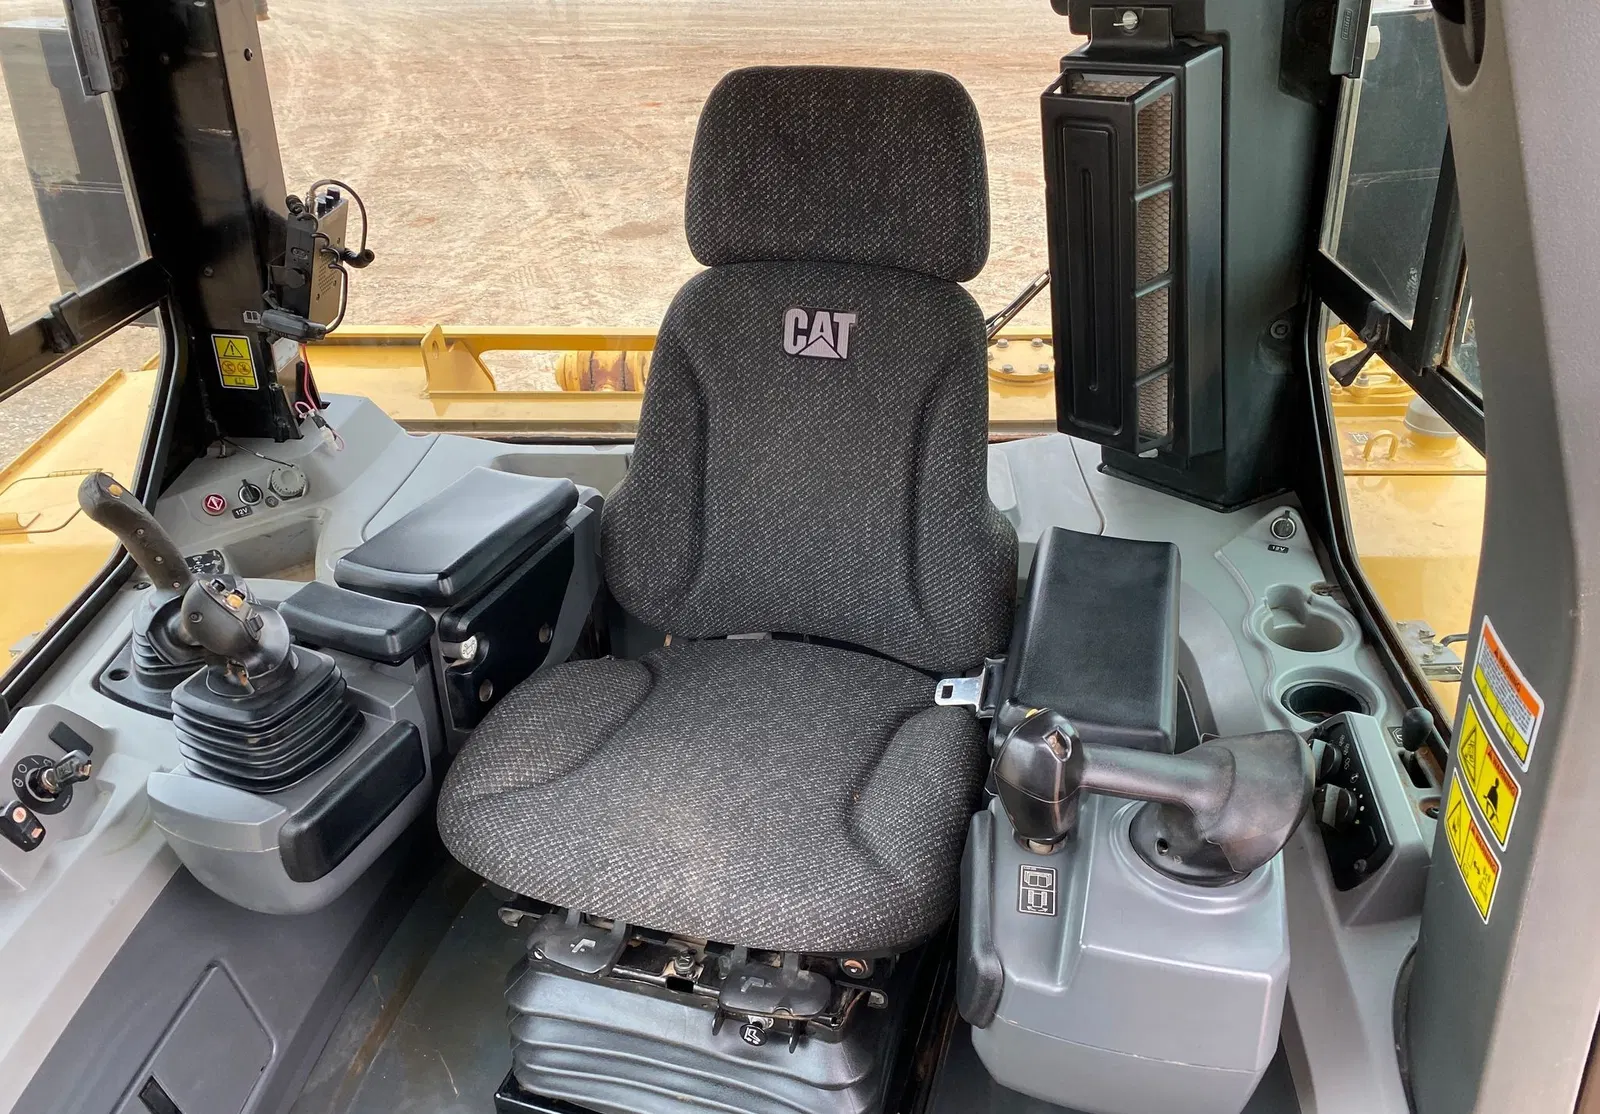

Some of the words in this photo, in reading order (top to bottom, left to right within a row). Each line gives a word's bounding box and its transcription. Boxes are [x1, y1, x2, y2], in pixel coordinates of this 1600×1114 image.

[783, 308, 856, 359] CAT
[235, 507, 248, 516] 12V
[1498, 655, 1521, 693] WARNING
